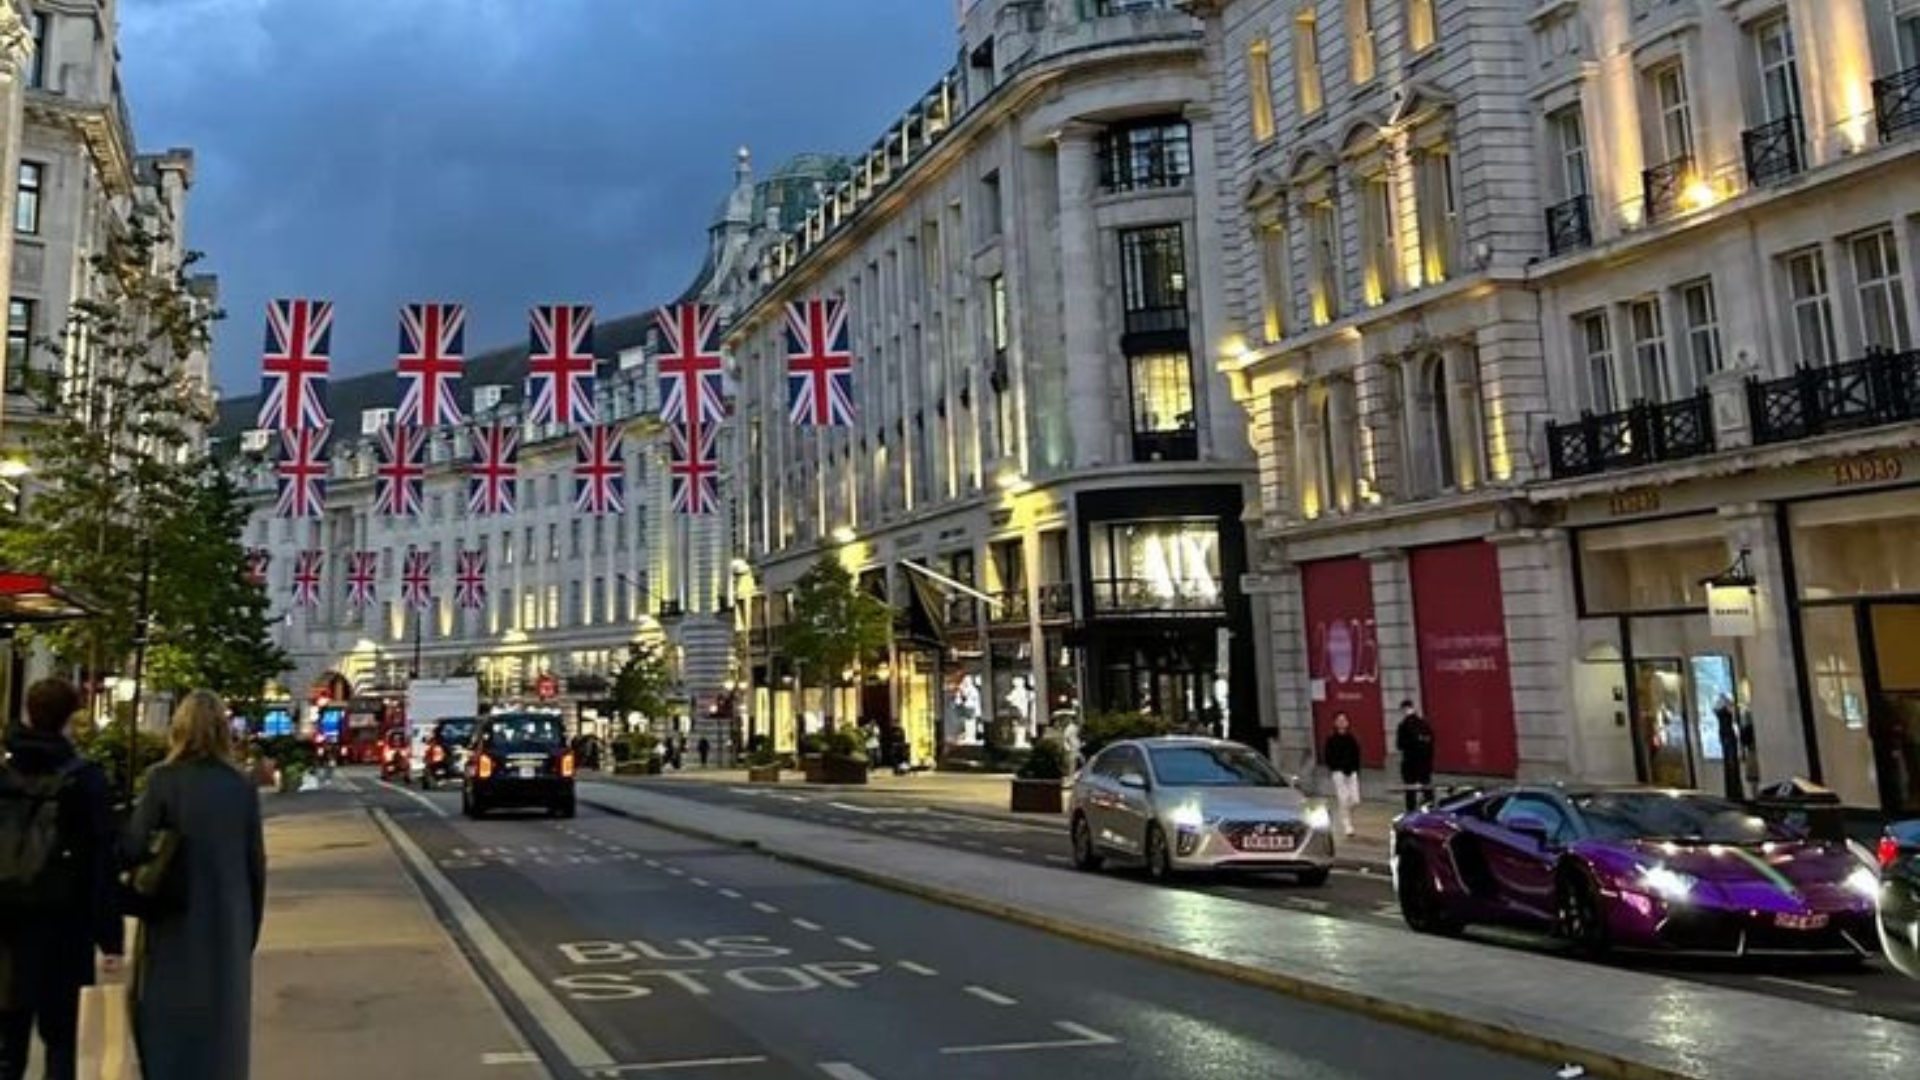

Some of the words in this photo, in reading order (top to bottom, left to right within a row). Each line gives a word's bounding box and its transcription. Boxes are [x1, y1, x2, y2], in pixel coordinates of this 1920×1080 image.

[1826, 457, 1902, 487] ANDRO
[558, 935, 792, 965] BUS
[553, 961, 881, 1000] STOP
